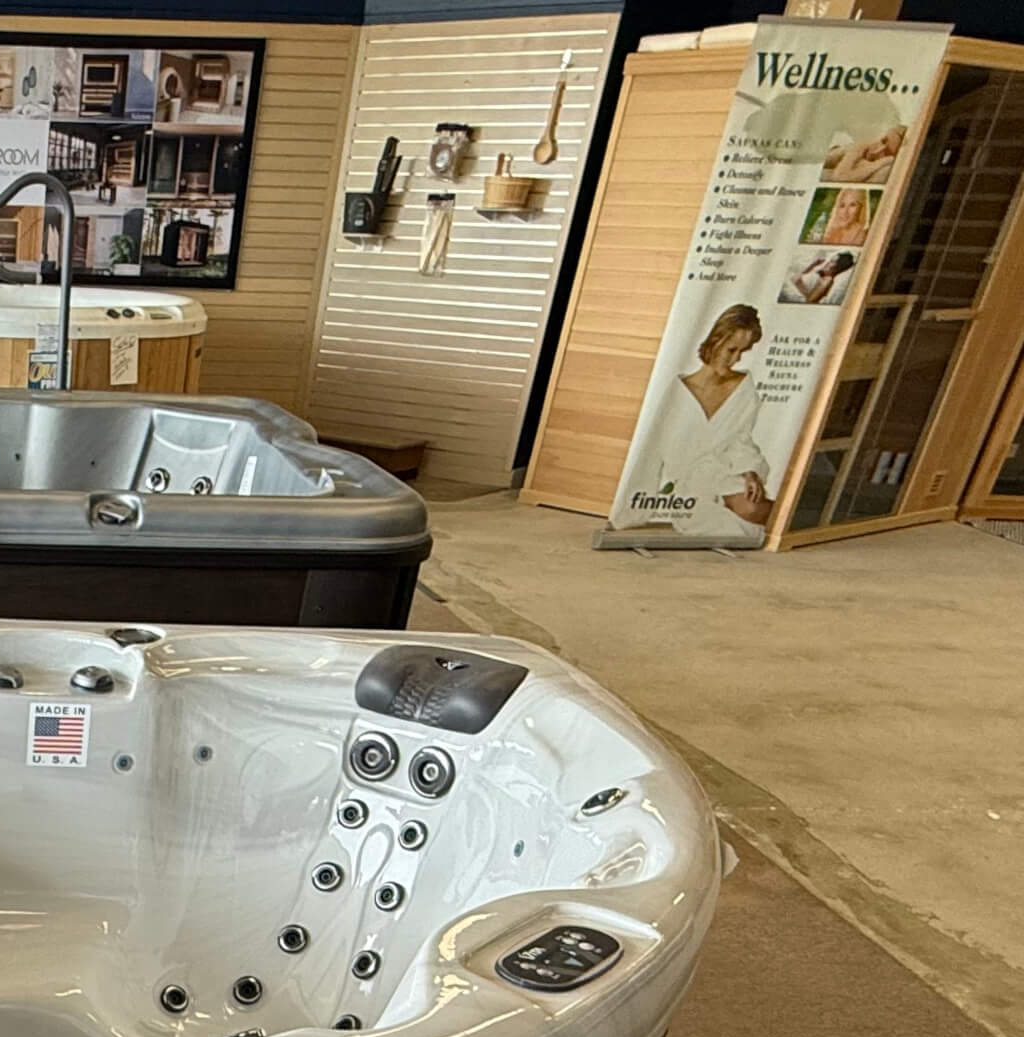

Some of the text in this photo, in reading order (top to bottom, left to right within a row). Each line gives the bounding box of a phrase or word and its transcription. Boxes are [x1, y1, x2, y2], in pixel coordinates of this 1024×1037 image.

[756, 51, 920, 95] Wellness...
[630, 491, 697, 510] finnleo
[35, 705, 86, 716] MADE IN
